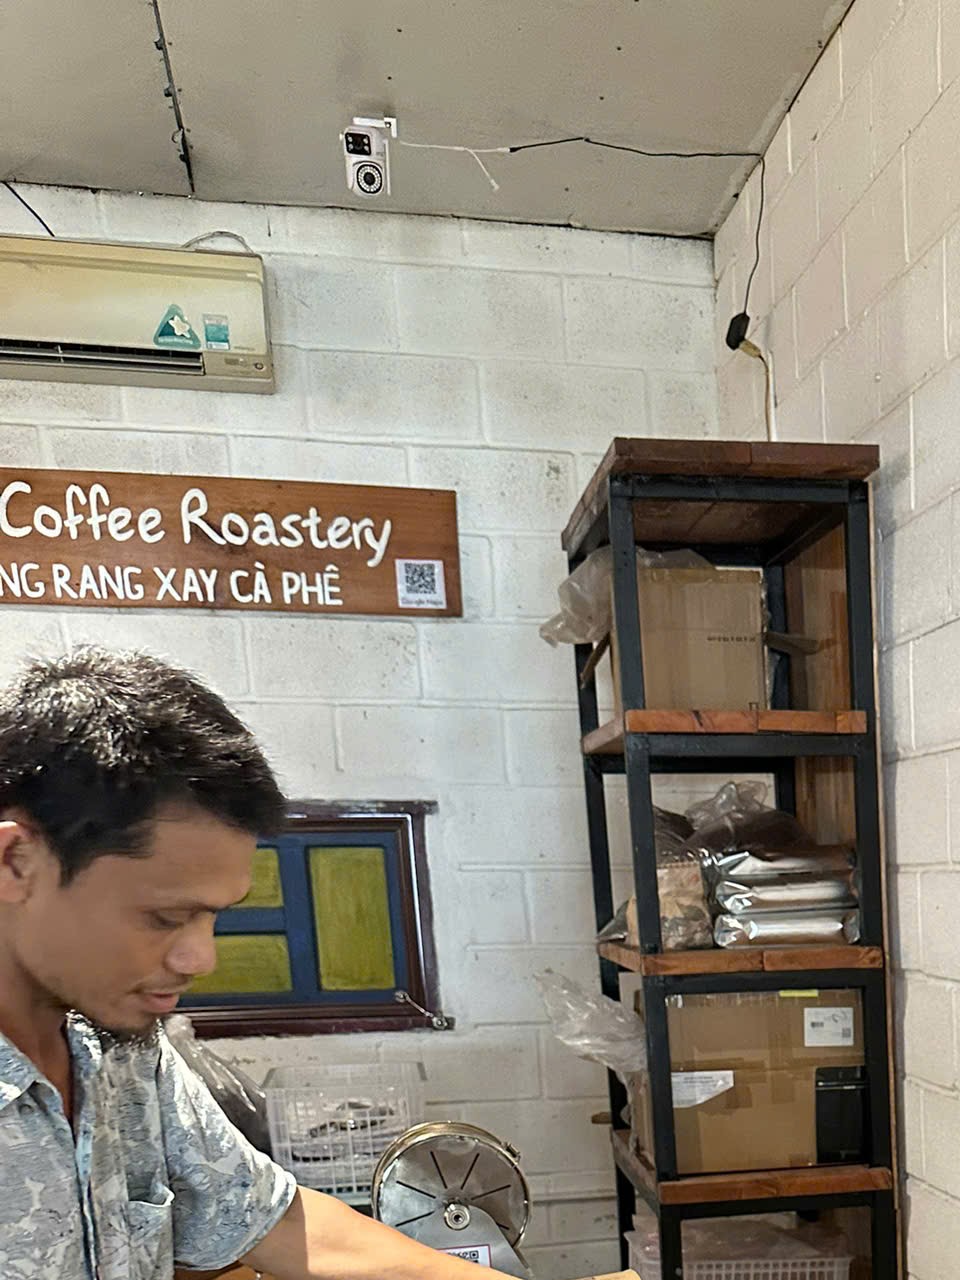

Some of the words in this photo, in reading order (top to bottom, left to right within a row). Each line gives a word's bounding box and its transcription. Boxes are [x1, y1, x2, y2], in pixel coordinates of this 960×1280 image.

[0, 481, 165, 543] Coffee
[181, 488, 392, 567] Roastery
[52, 563, 145, 600] RANG
[153, 567, 218, 602] XAY
[229, 561, 272, 603] CÀ
[281, 563, 343, 606] PHÊ
